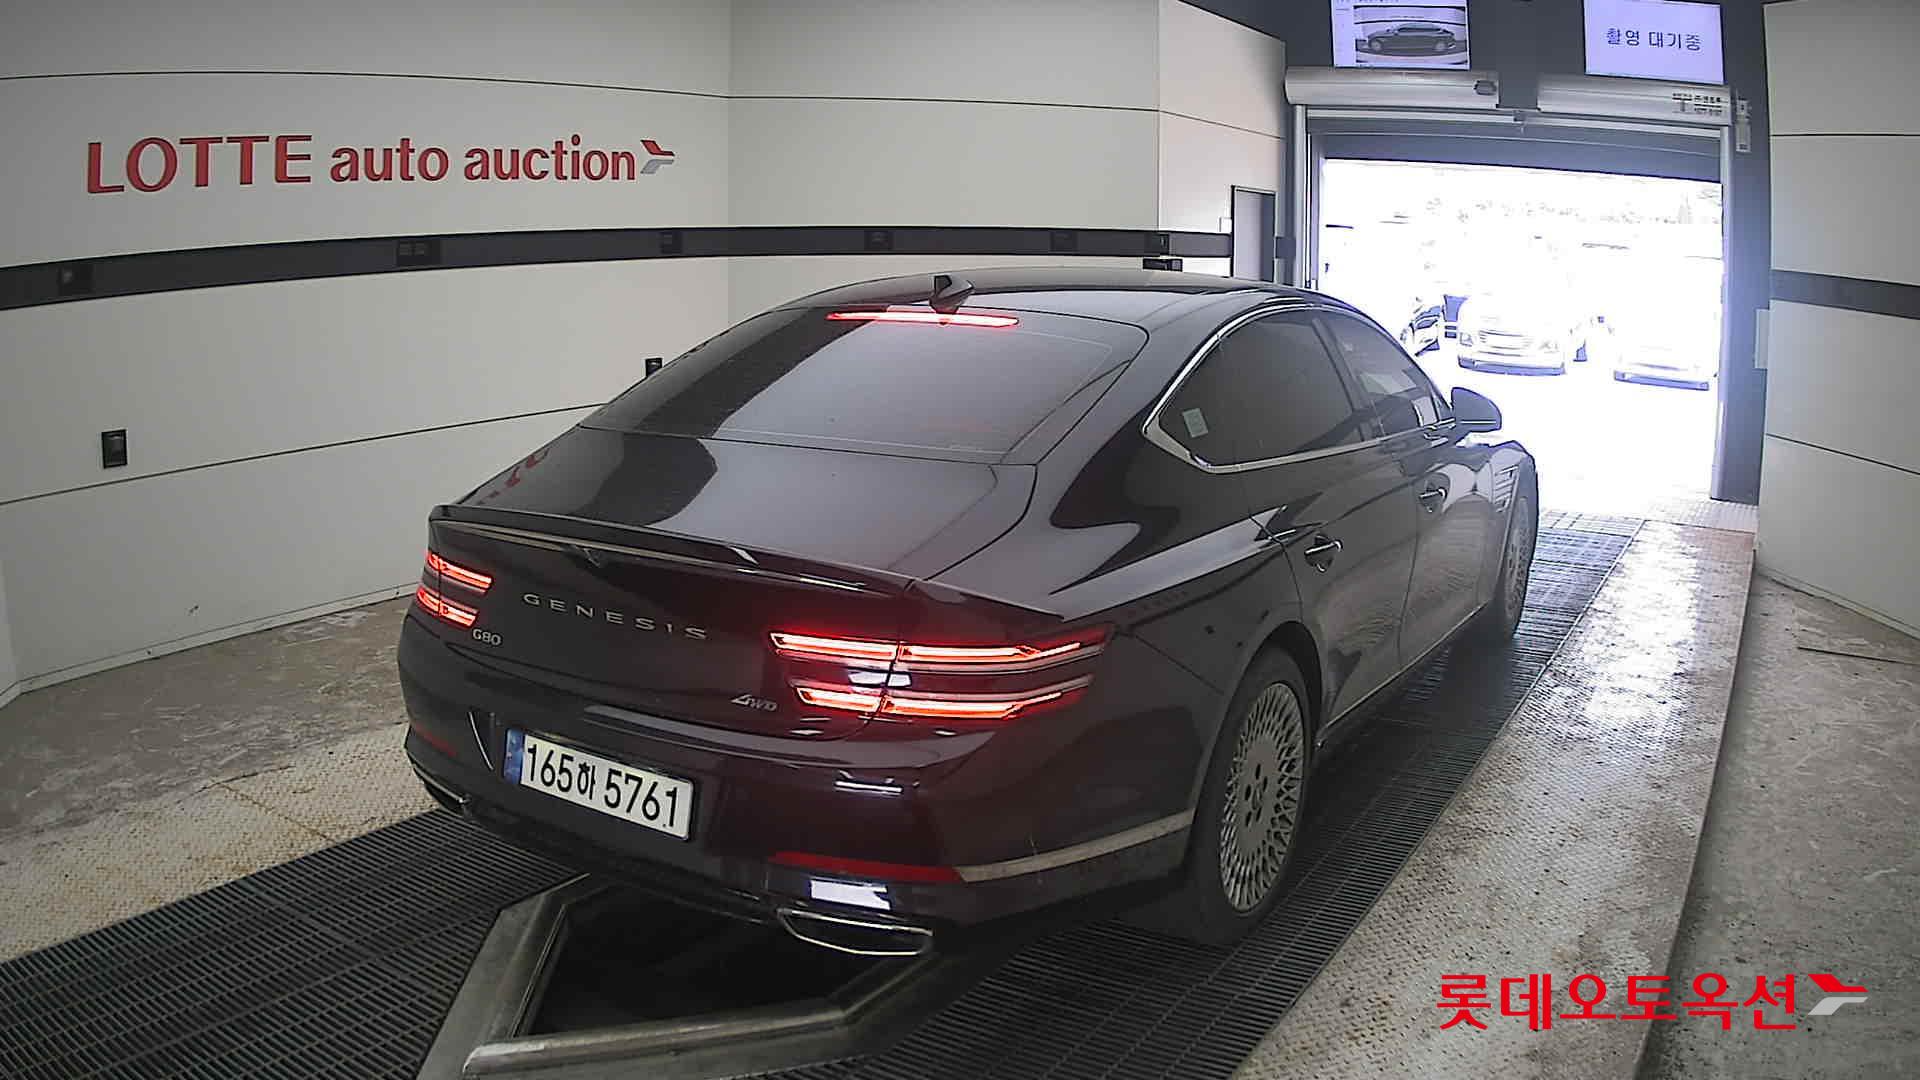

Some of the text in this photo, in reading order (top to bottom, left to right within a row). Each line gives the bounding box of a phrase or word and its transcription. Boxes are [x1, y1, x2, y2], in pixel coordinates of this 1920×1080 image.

[1647, 31, 1701, 52] 대기중
[87, 134, 636, 193] LOTTE auto auction
[472, 628, 502, 646] G80
[522, 592, 707, 641] GENESIS
[527, 743, 679, 828] 165하 5761
